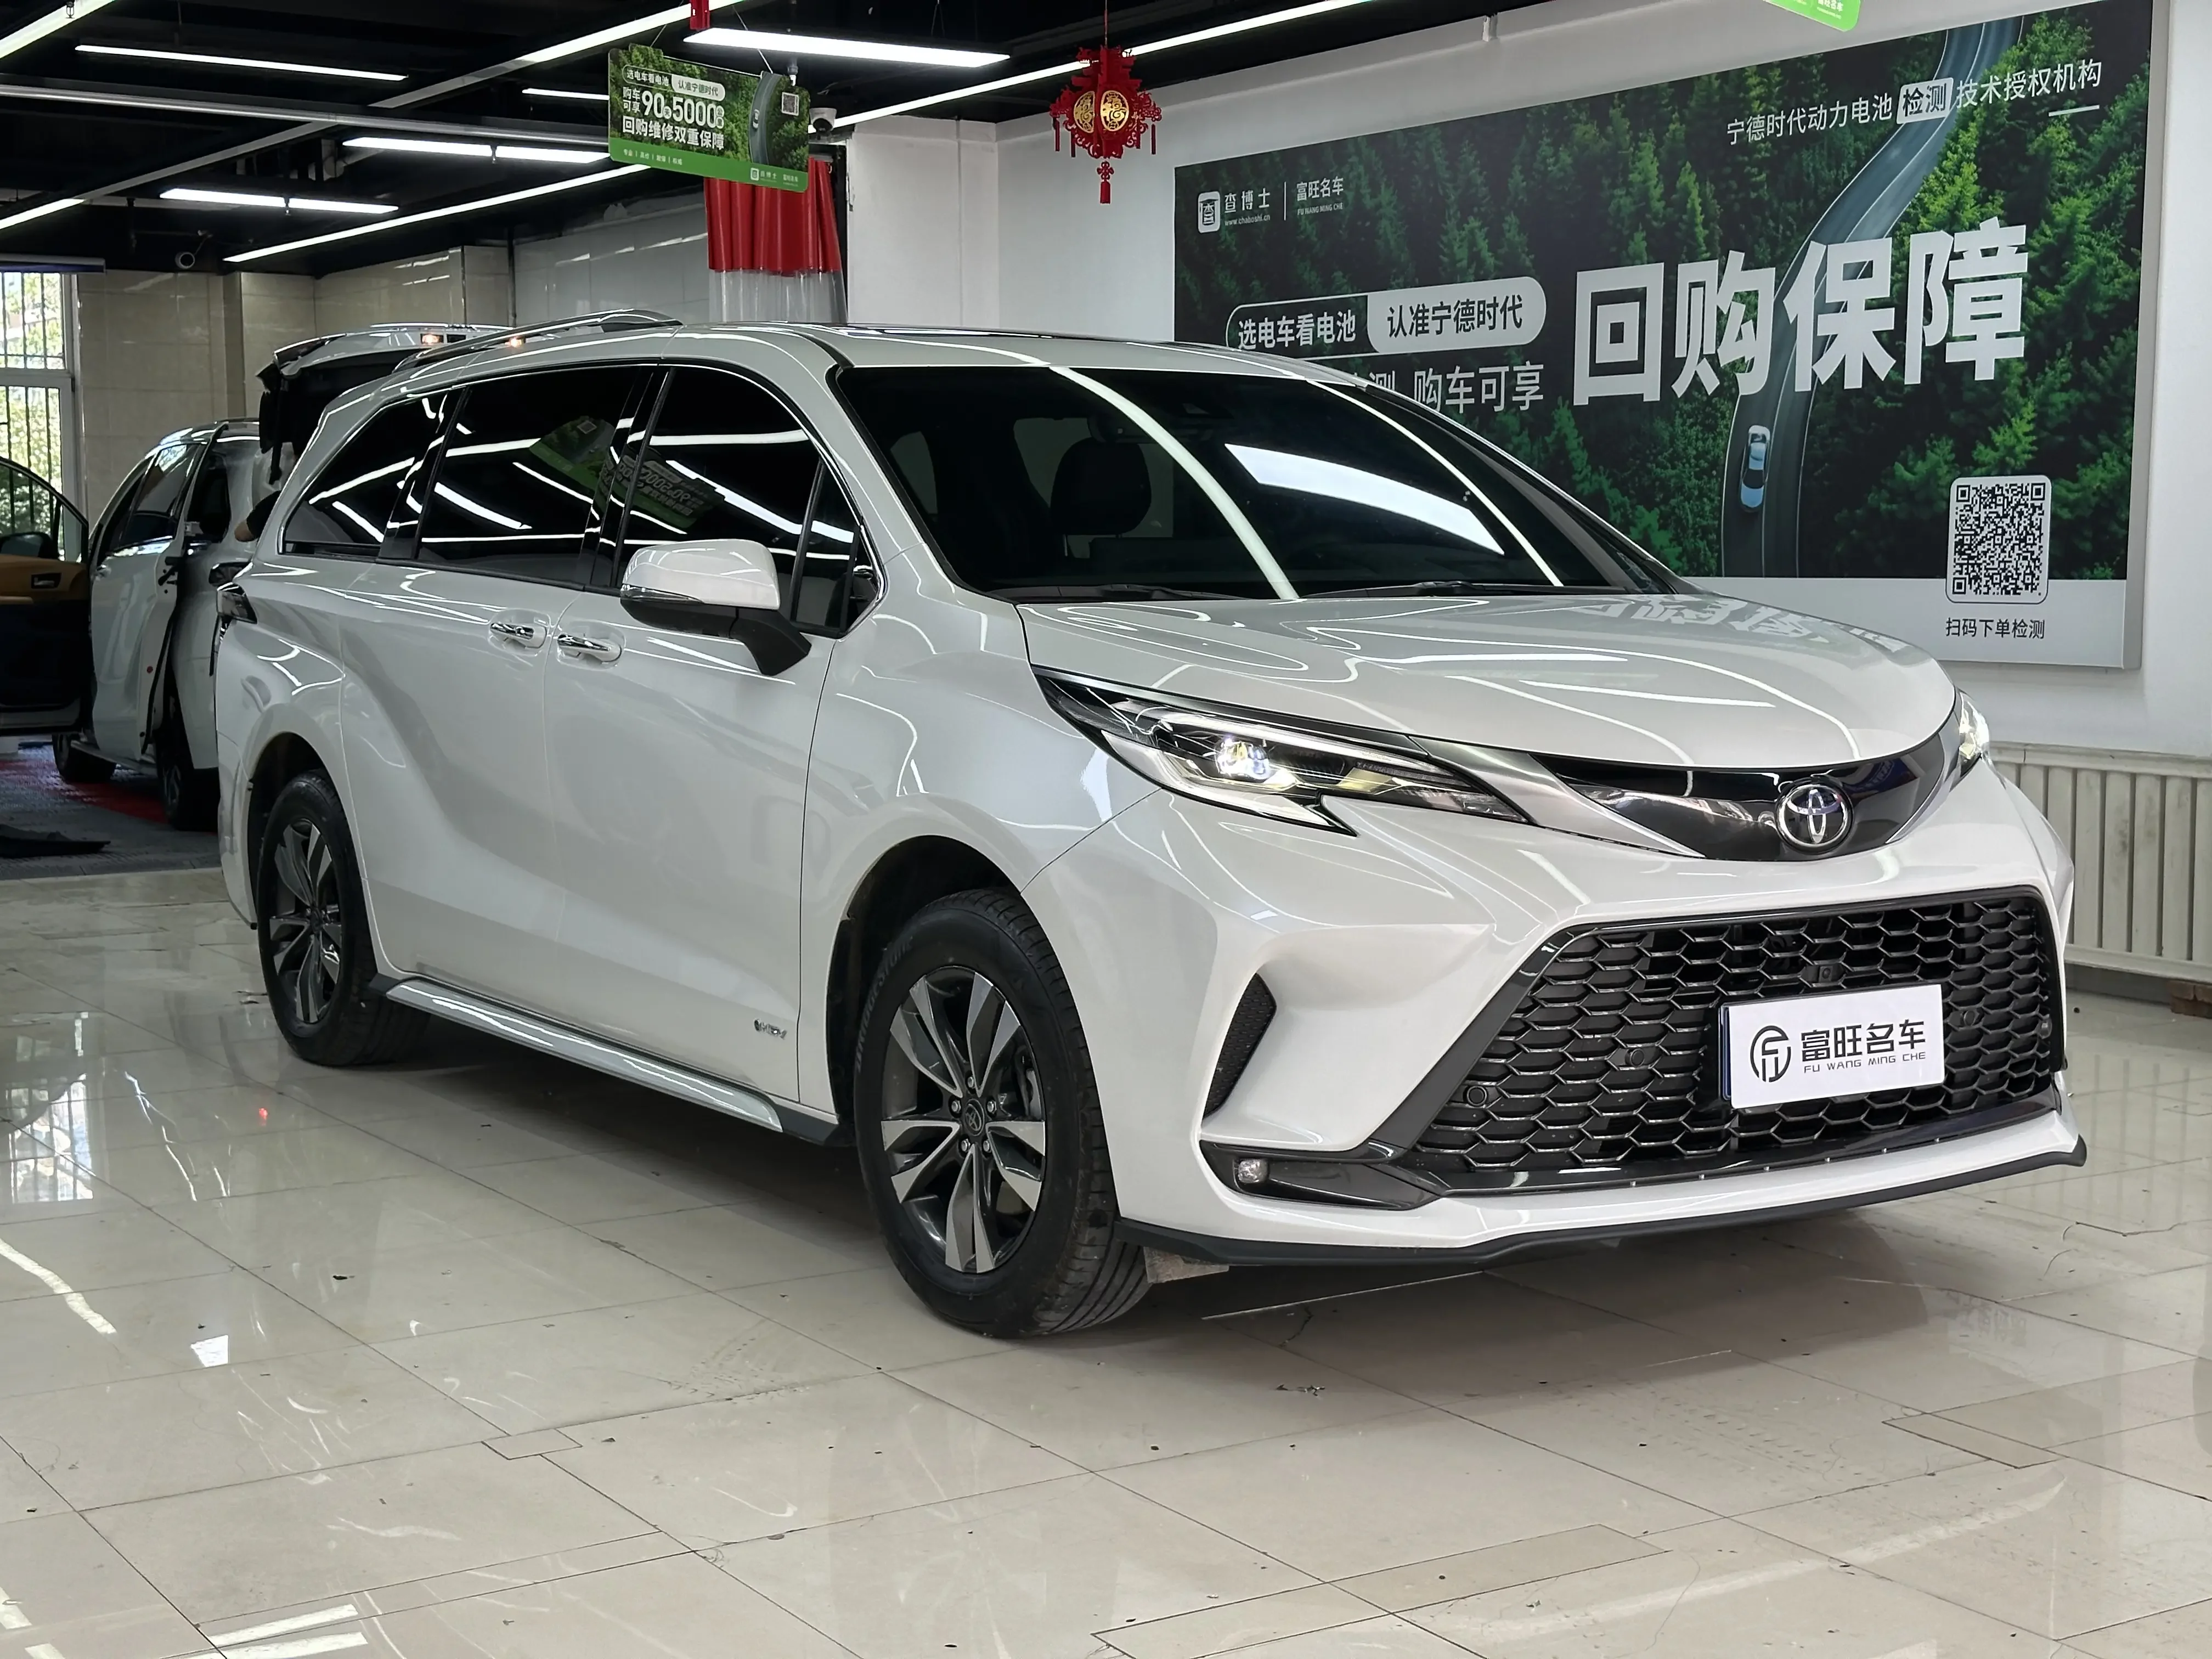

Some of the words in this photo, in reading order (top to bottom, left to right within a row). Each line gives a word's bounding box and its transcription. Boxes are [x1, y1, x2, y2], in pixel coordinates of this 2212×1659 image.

[623, 86, 641, 100] 购车
[627, 69, 669, 87] 选电车看电池
[678, 80, 719, 97] 认准宁德时代
[622, 115, 724, 150] 回购维修双重保障
[1224, 187, 1271, 213] 查博士
[1296, 176, 1344, 201] 富旺名车
[1305, 206, 1319, 215] WANG
[1319, 204, 1333, 212] MING
[1333, 202, 1344, 211] CHE
[1238, 309, 1357, 351] 选电车看电池
[1387, 294, 1523, 338] 认准宁德时代
[1573, 216, 2028, 405] 回购保障
[1945, 617, 2045, 640] 扫码下单检测
[1801, 1019, 1926, 1062] 富旺名车
[1804, 1064, 1821, 1074] FU
[1827, 1059, 1862, 1070] WANG
[1868, 1054, 1897, 1066] MING
[1902, 1051, 1926, 1062] CHE
